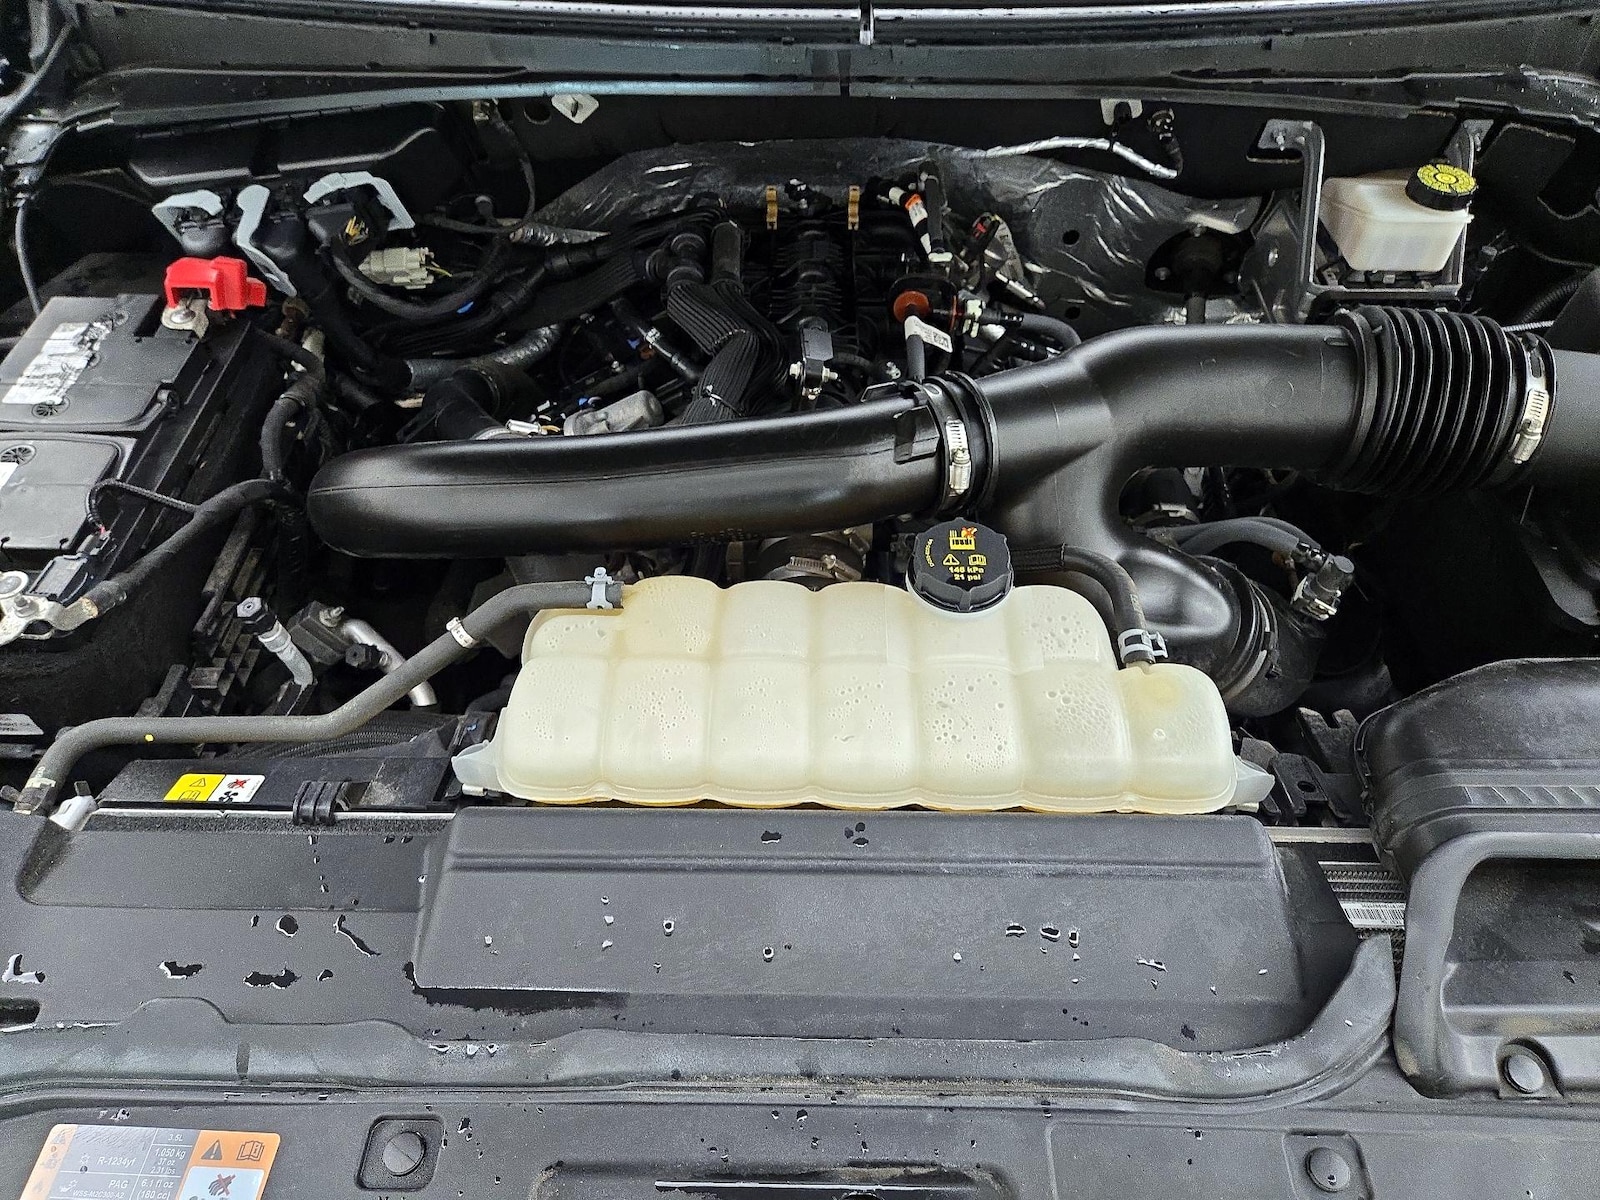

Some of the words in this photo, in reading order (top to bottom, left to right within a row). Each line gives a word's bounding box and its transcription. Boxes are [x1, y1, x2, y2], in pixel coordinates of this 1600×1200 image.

[175, 1149, 186, 1160] kg
[96, 1156, 137, 1168] R-1234yf
[108, 1180, 129, 1189] PAG
[141, 1178, 154, 1187] 6.1
[155, 1179, 163, 1188] fl
